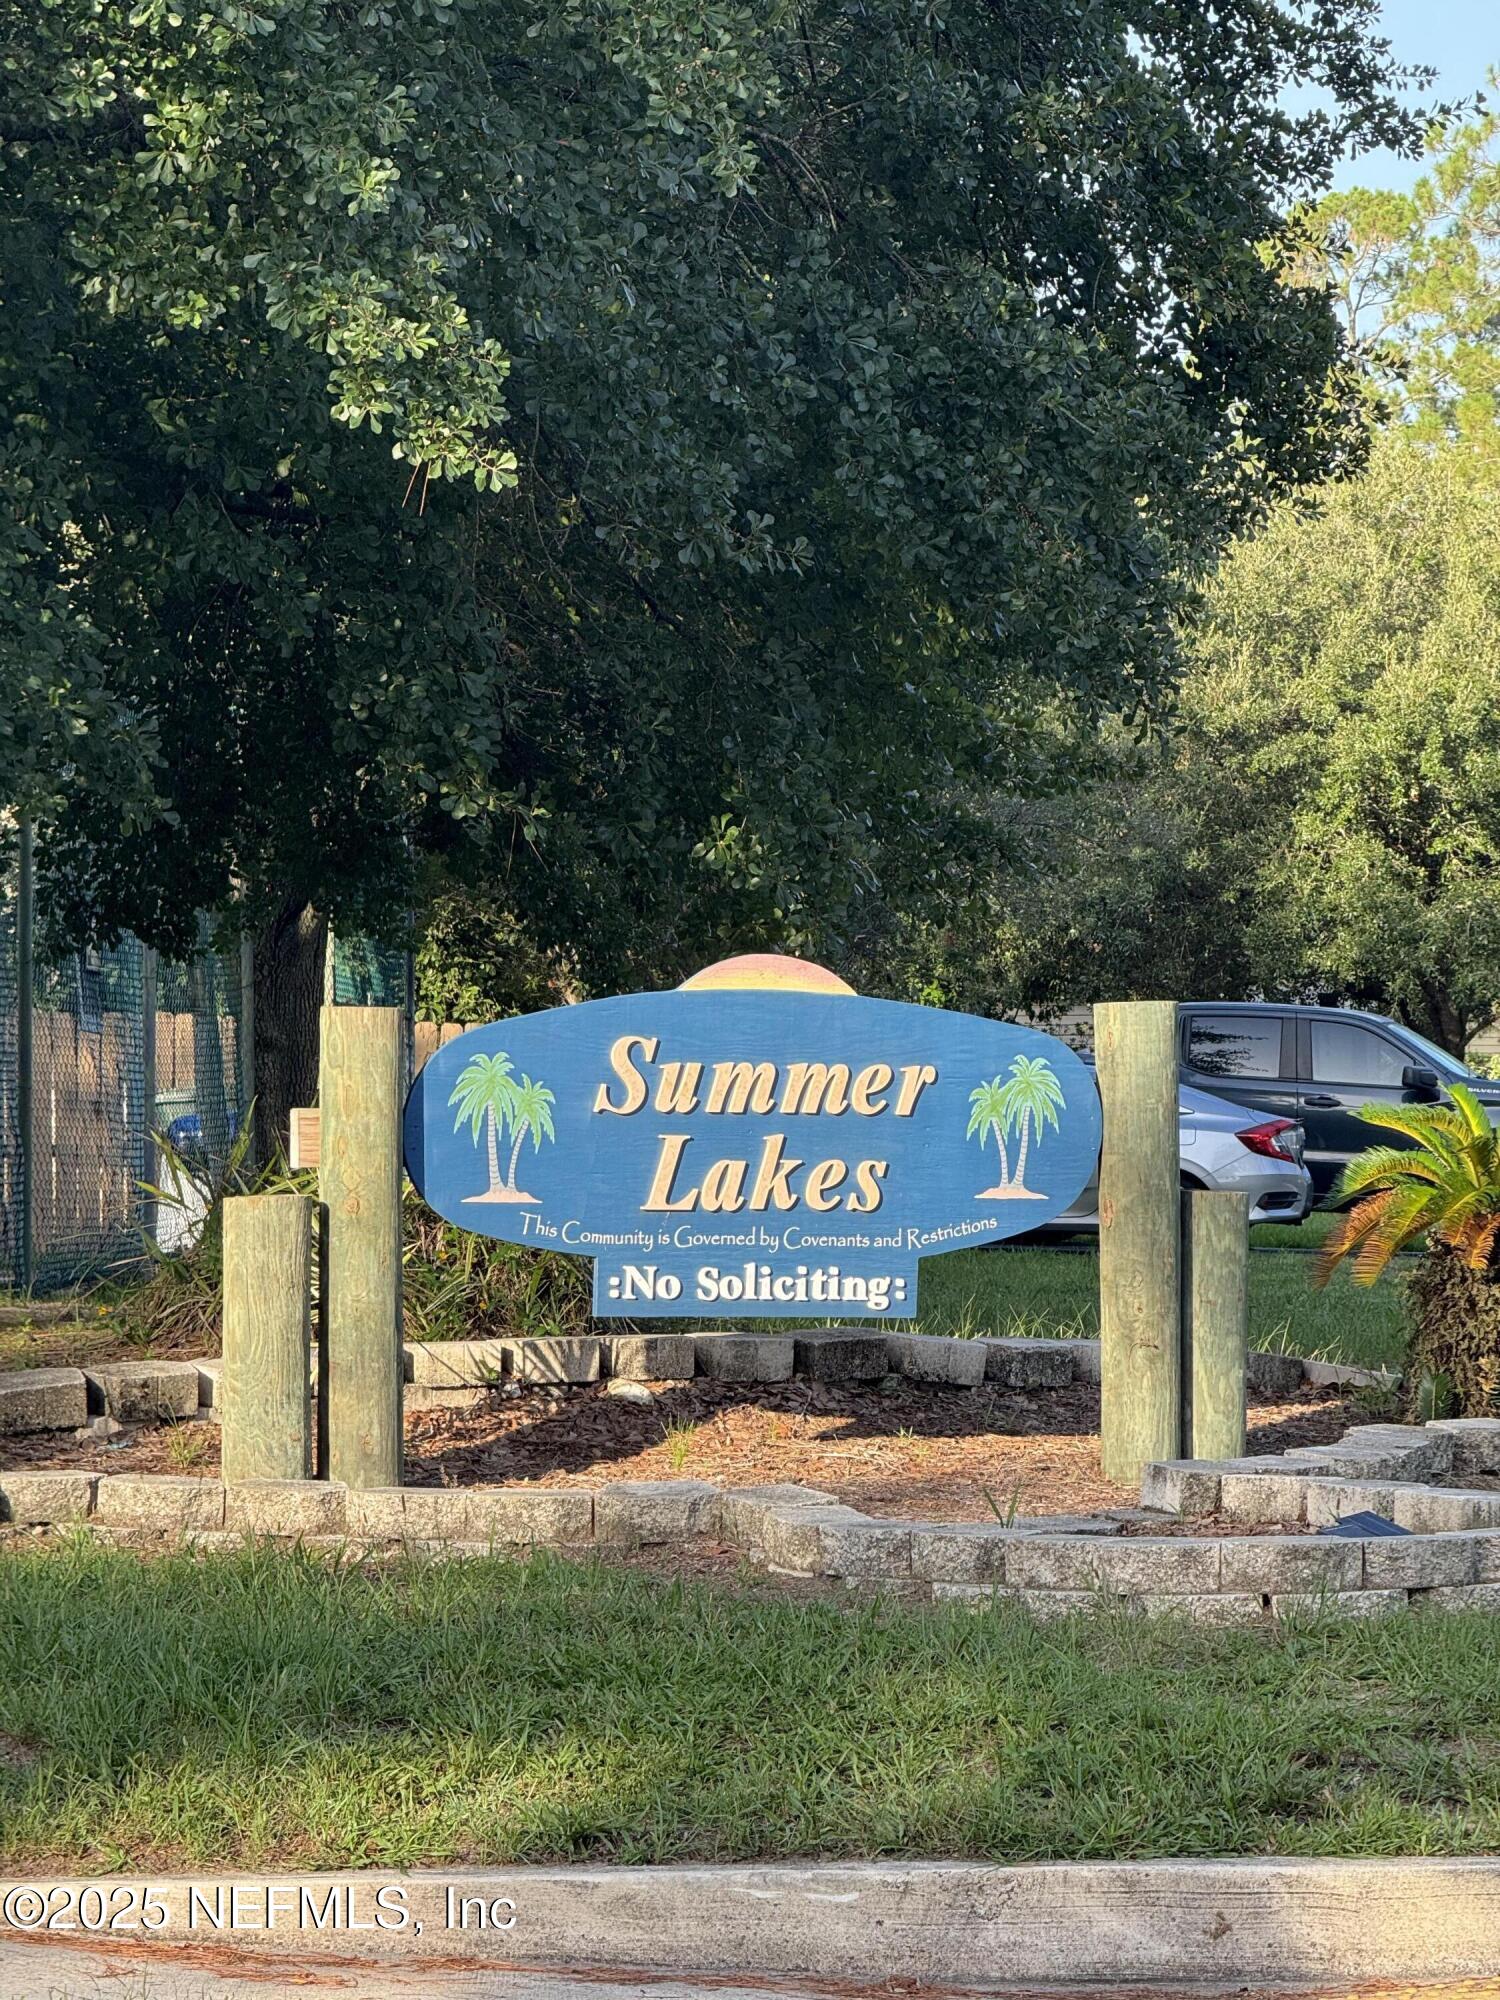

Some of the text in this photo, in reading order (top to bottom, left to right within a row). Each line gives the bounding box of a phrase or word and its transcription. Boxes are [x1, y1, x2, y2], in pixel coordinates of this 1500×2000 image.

[593, 1035, 937, 1117] Summer
[640, 1133, 889, 1213] Lakes
[520, 1211, 998, 1253] This Community is Governed by Covenants and Restrictions
